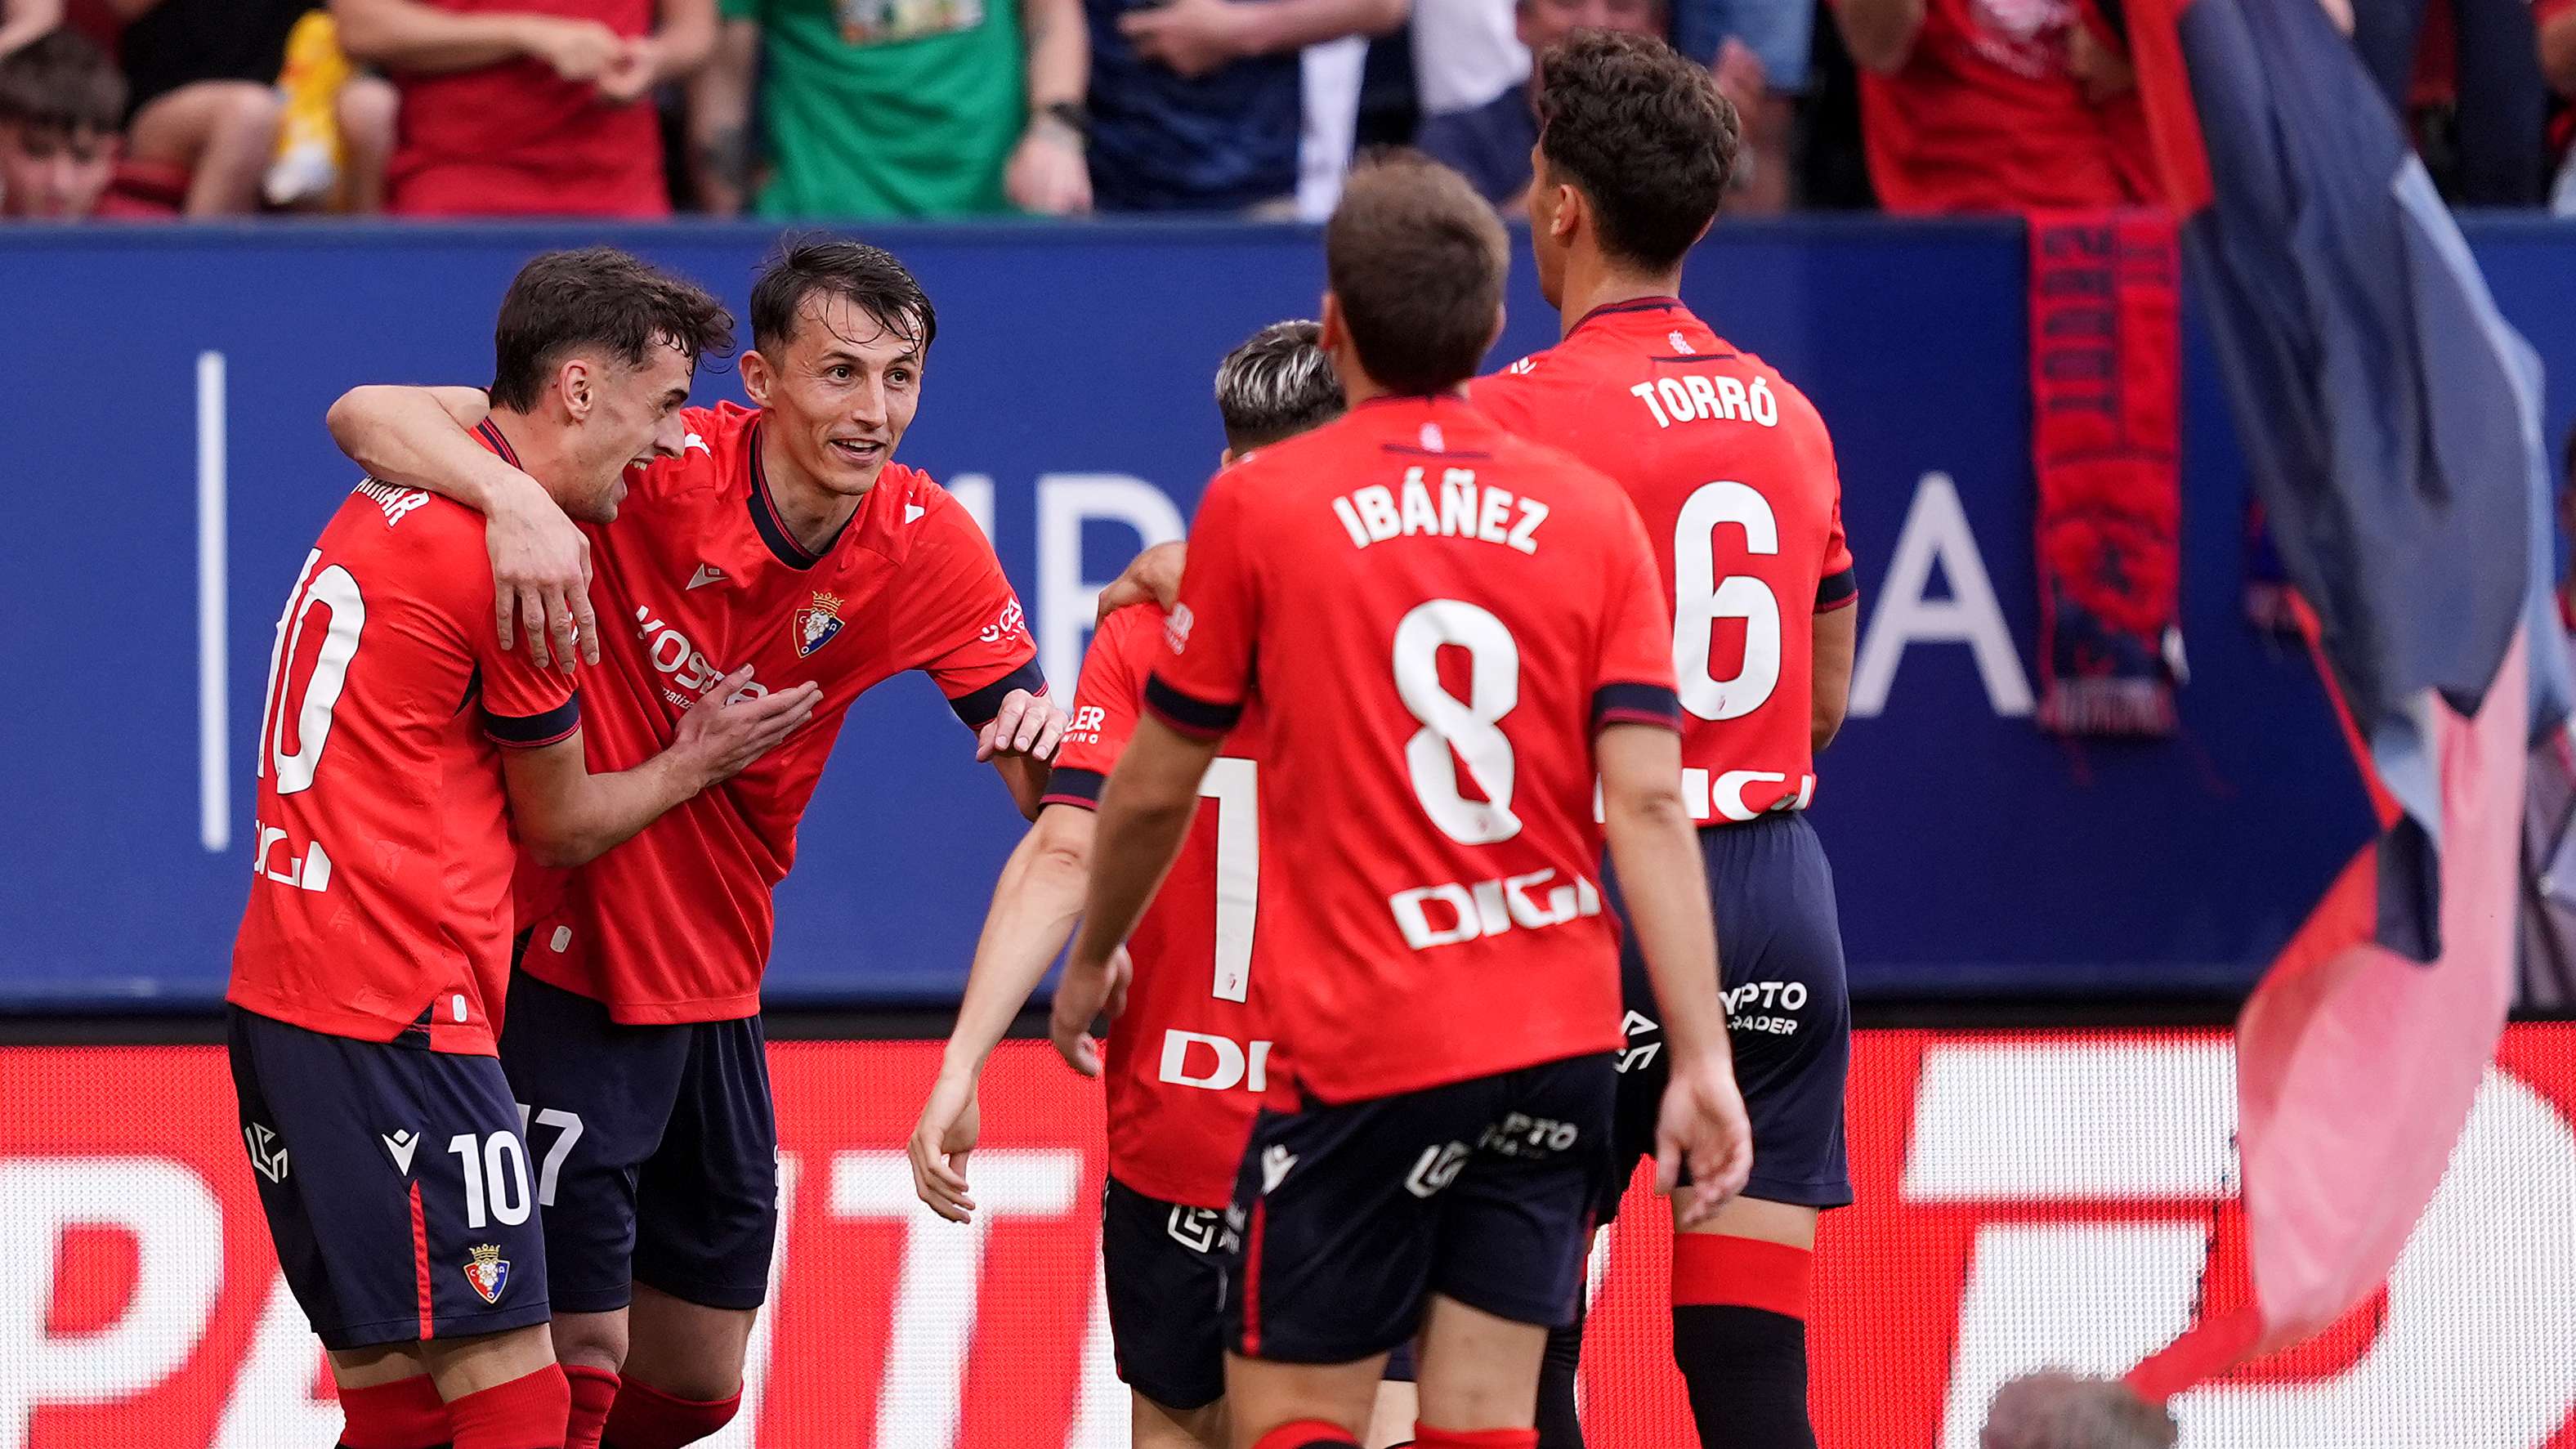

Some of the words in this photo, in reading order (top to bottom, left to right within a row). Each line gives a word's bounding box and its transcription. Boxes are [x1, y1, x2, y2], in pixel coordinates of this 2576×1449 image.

[1630, 375, 1778, 428] TORRÓ
[1331, 467, 1550, 556] IBÁÑEZ
[1675, 480, 1782, 721] 6
[257, 546, 366, 795] 10
[1392, 598, 1523, 846] 8
[1390, 867, 1601, 950] DIGI
[1719, 982, 1808, 1015] YPTO
[1159, 1028, 1274, 1092] DI
[448, 1130, 531, 1229] 10
